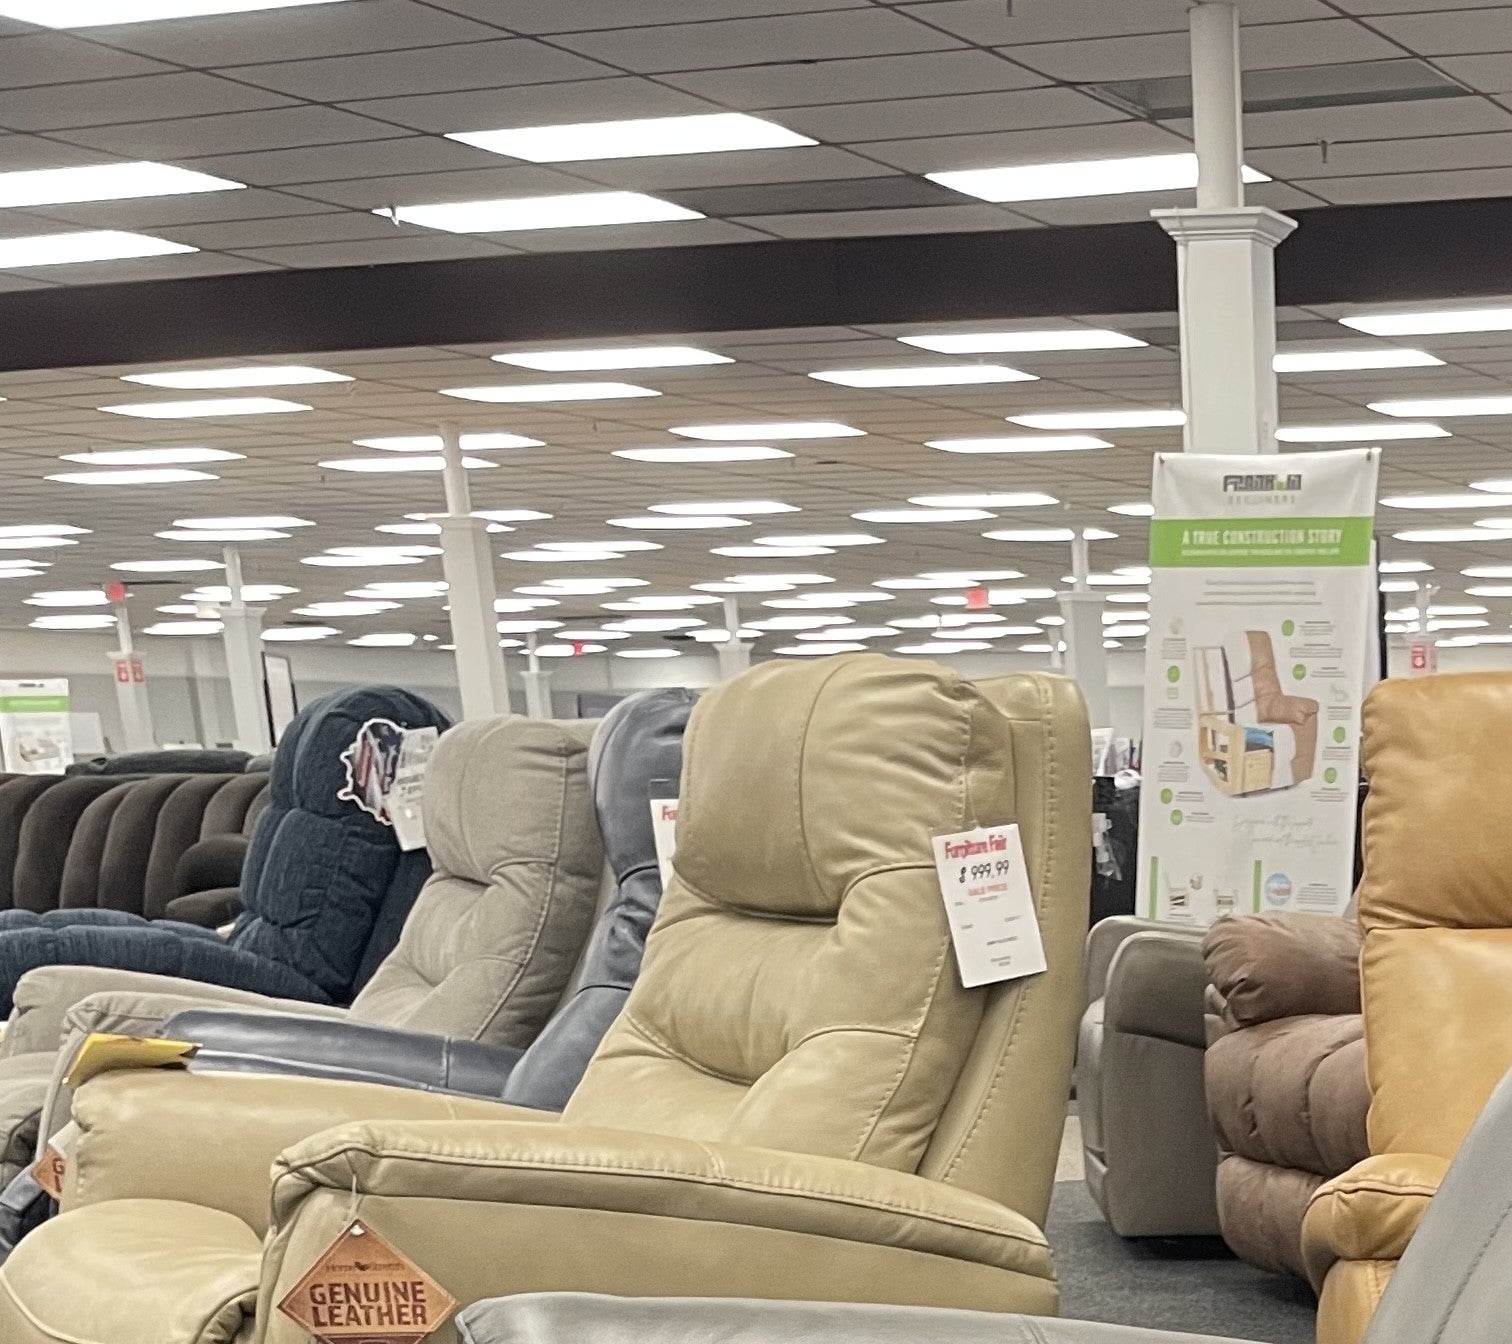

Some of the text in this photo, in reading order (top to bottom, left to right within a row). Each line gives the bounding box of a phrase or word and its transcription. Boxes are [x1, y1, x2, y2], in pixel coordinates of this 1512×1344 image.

[1182, 528, 1342, 545] A TRUE CONSTRUCTION STORY
[971, 859, 1009, 880] 999.99
[309, 1280, 427, 1305] GENUINE
[311, 1303, 428, 1328] LEATHER
